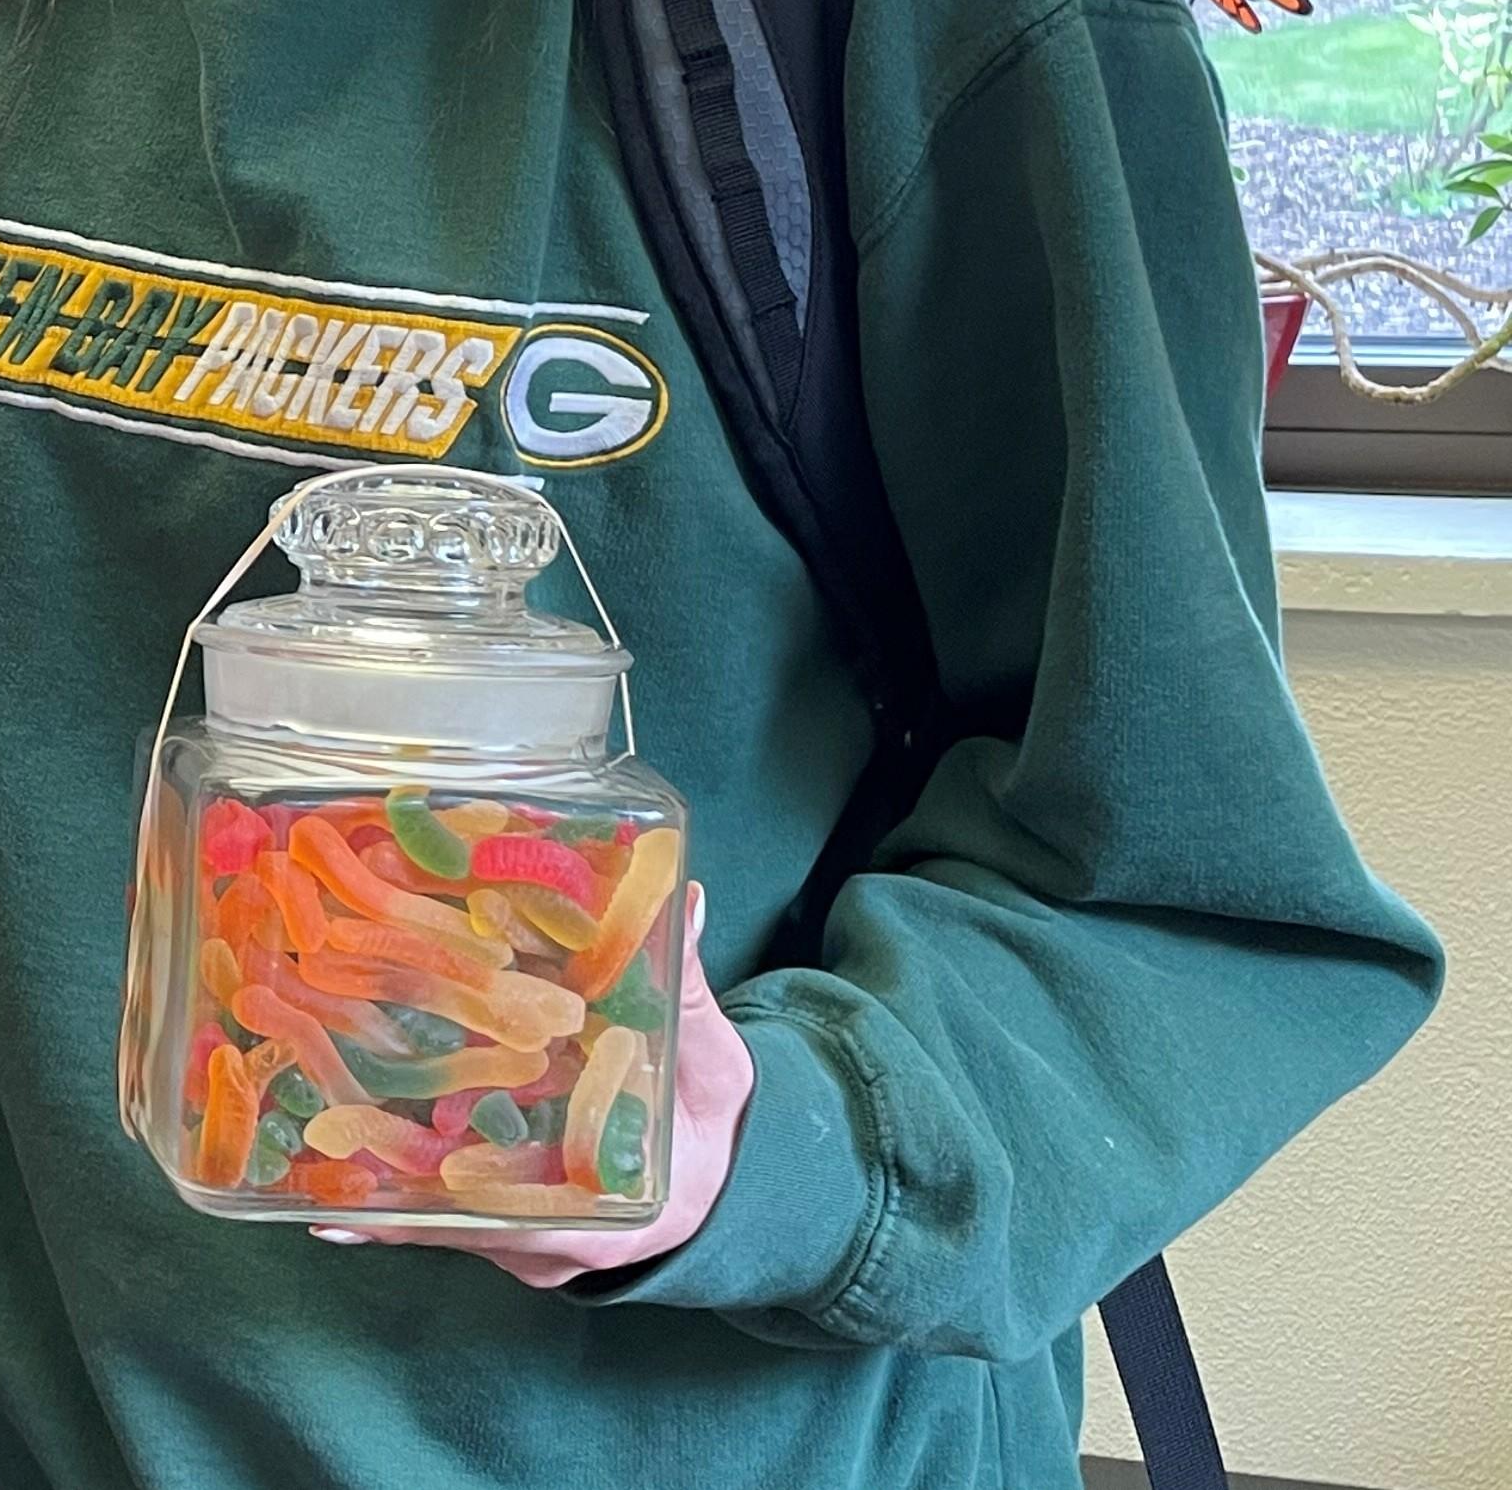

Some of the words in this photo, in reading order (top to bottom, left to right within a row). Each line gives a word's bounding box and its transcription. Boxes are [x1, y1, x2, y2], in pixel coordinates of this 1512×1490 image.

[50, 280, 223, 392] BAY
[173, 301, 493, 441] PACKERS
[504, 336, 654, 450] G
